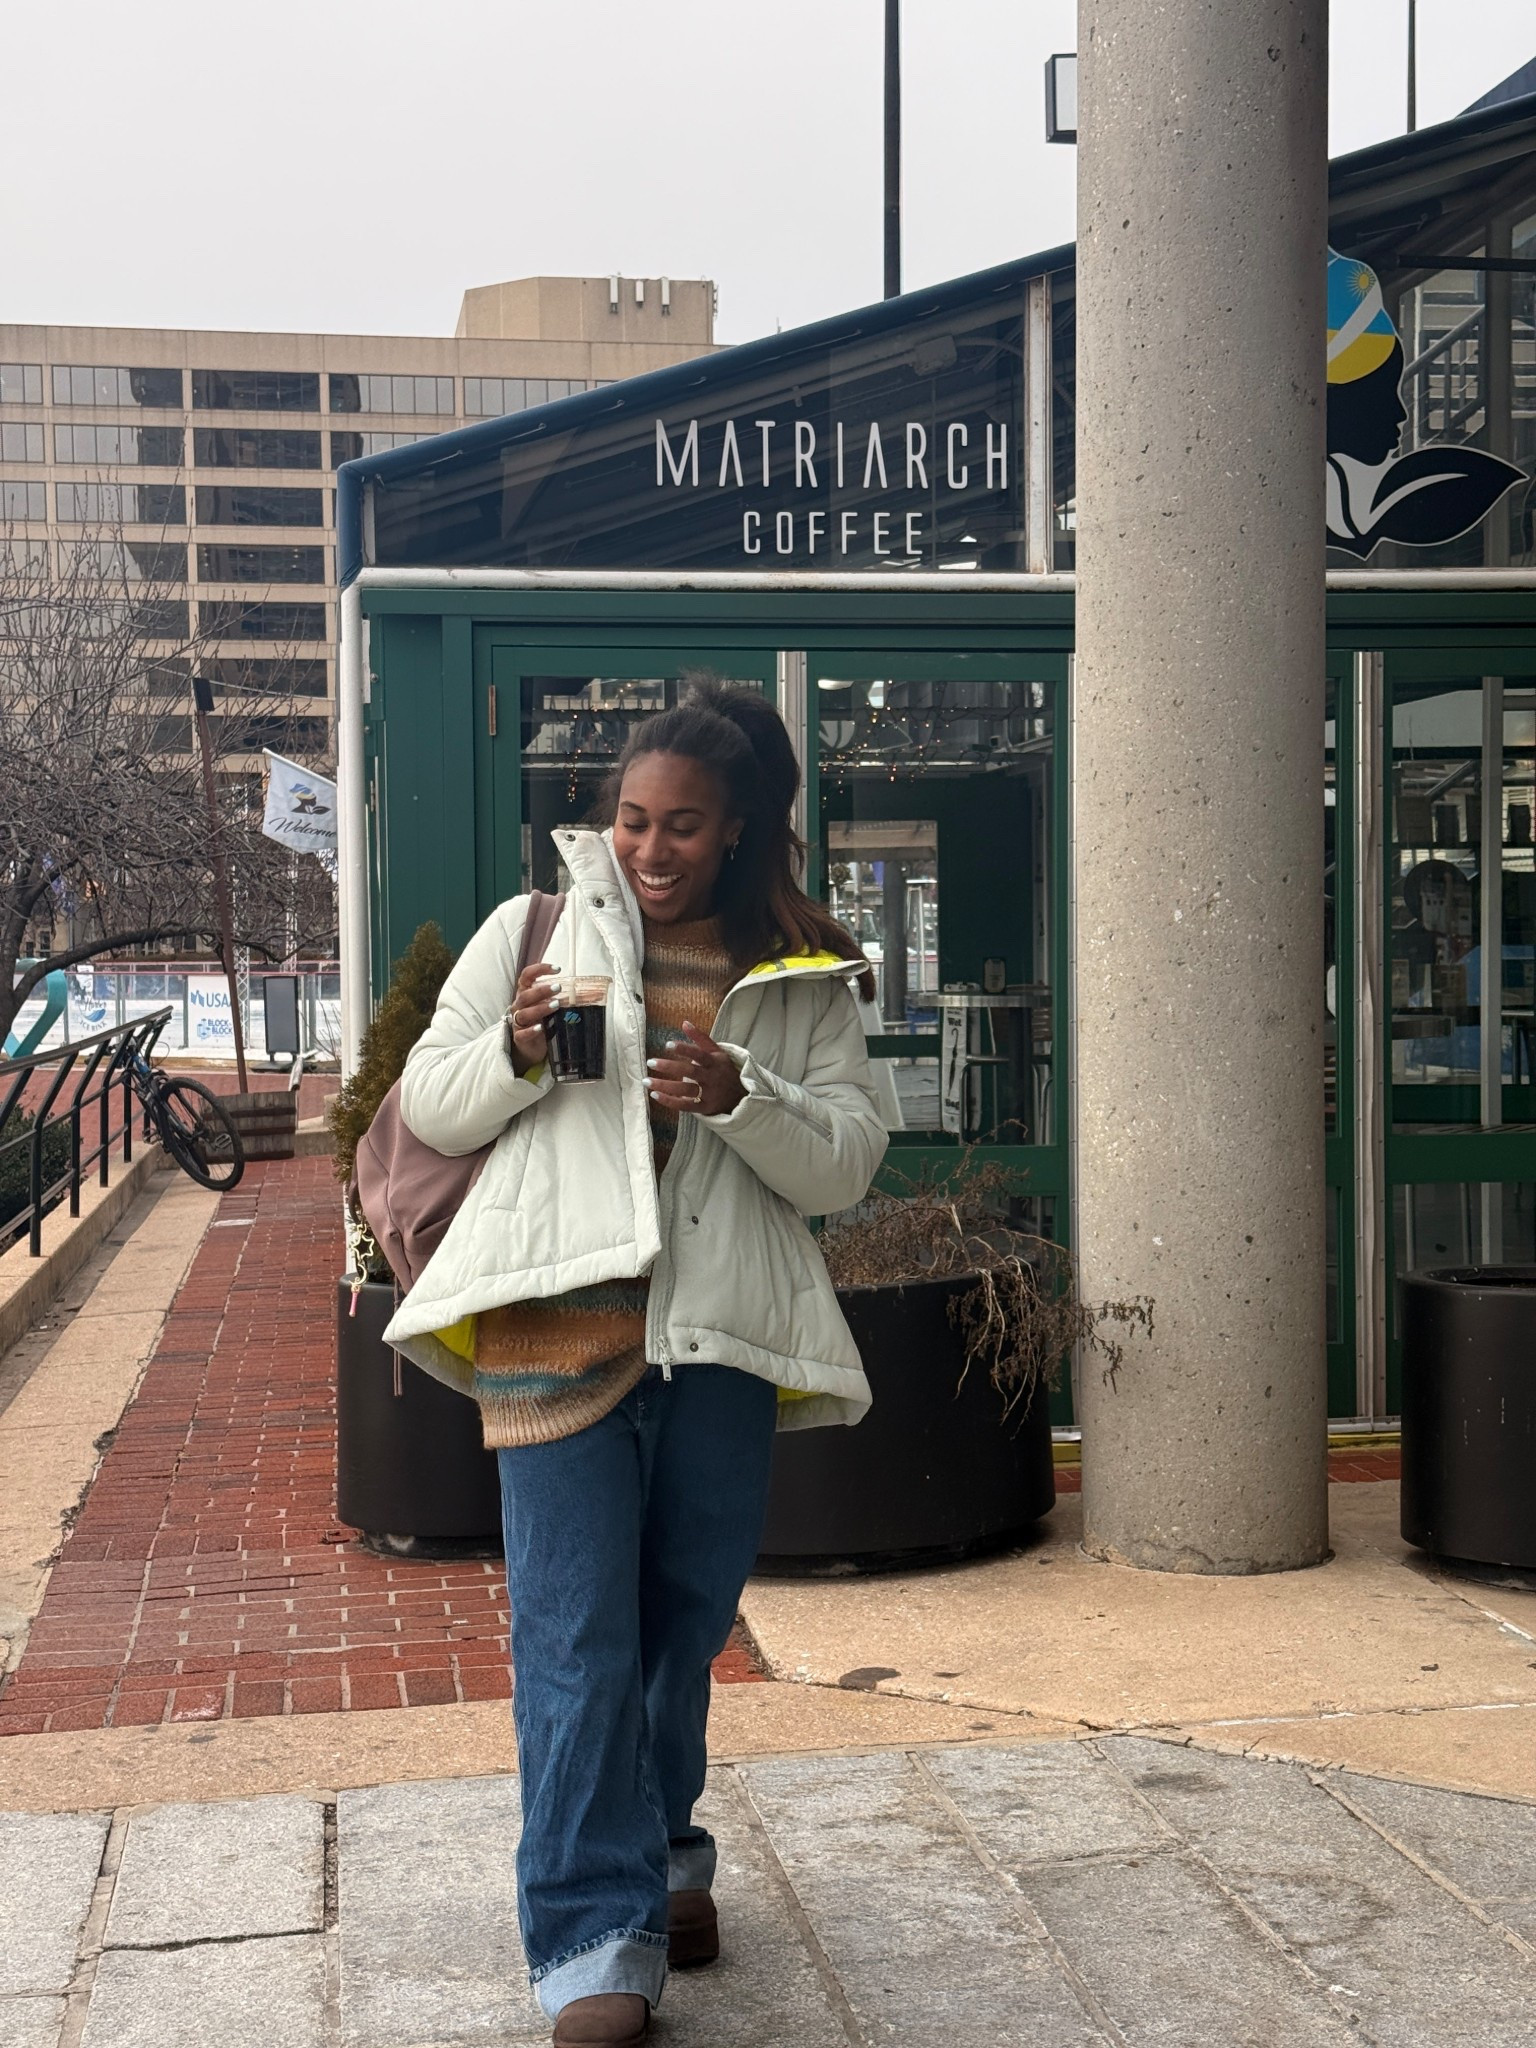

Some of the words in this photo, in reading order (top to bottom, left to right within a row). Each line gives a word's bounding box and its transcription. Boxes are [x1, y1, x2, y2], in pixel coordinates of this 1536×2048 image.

[656, 418, 1008, 490] MATRIARCH
[743, 511, 923, 555] COFFEE
[212, 1026, 232, 1035] BLOCK
